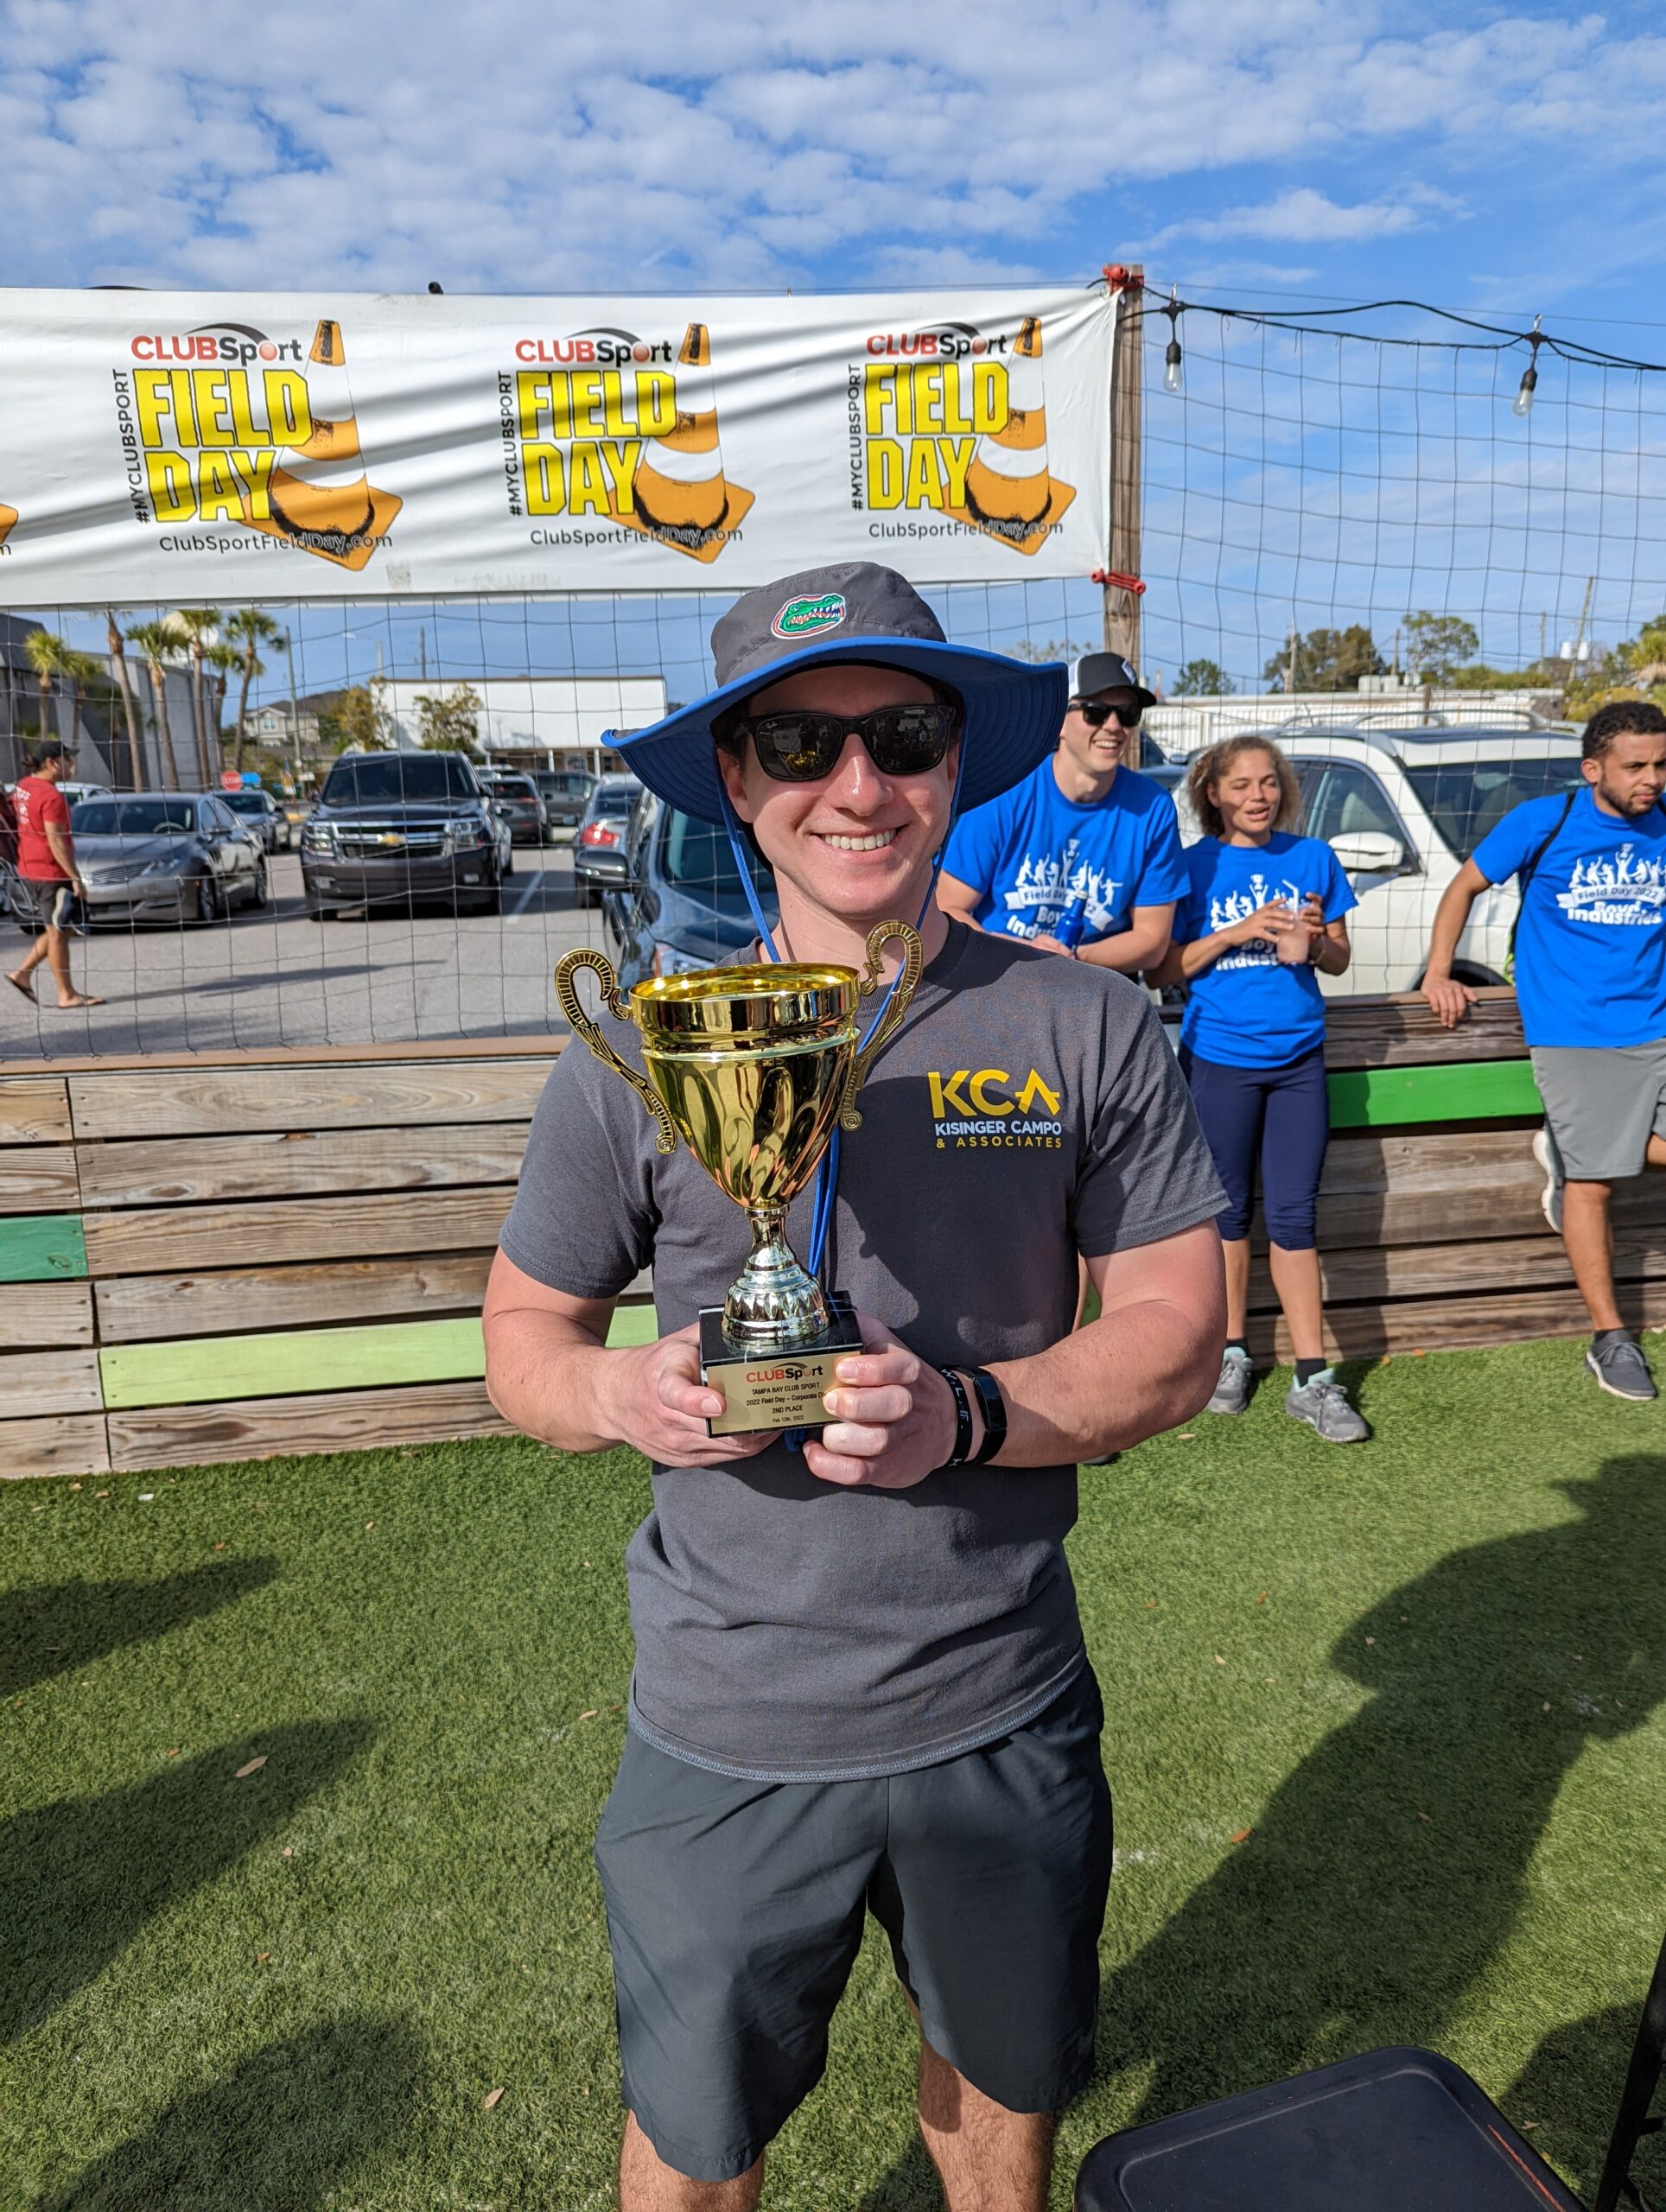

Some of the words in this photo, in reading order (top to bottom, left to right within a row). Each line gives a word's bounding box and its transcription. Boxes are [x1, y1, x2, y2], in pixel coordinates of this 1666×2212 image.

[131, 335, 302, 366] CLUBSport
[515, 340, 672, 367] CLUBSport
[866, 334, 1007, 360] CLUBSport
[132, 369, 314, 448] FIELD
[516, 370, 677, 439] FIELD
[865, 361, 1009, 435] FIELD
[112, 369, 152, 524] #MYCLUBSPORT
[498, 371, 523, 516] #MYCLUBSPORT
[848, 364, 864, 511] #MYCLUBSPORT
[521, 441, 643, 516] DAY
[866, 438, 976, 510] DAY
[143, 450, 277, 523] DAY
[530, 525, 743, 547] ClubSportFieldDay.com
[868, 520, 1064, 541] ClubSportFieldDay.com
[159, 531, 393, 553] ClubSportFieldDay.com
[1023, 889, 1052, 901] Field
[1578, 887, 1607, 900] Field
[1611, 887, 1632, 897] Day
[1633, 887, 1658, 899] 2022
[1036, 906, 1066, 928] Boy
[1240, 938, 1277, 954] Boy
[1215, 952, 1280, 971] Indust
[927, 1068, 1061, 1119] KCA
[934, 1120, 1007, 1136] KISINGER
[1011, 1120, 1062, 1135] CAMPO
[936, 1138, 945, 1148] &
[956, 1135, 1062, 1148] ASSOCIATES
[746, 1365, 823, 1383] CLUBSport
[785, 1384, 800, 1393] CLUB
[800, 1382, 820, 1390] SPORT
[761, 1396, 774, 1405] Field
[774, 1395, 785, 1404] Day
[792, 1393, 817, 1402] Corporate
[772, 1406, 784, 1414] 2ND
[785, 1404, 804, 1413] PLACE
